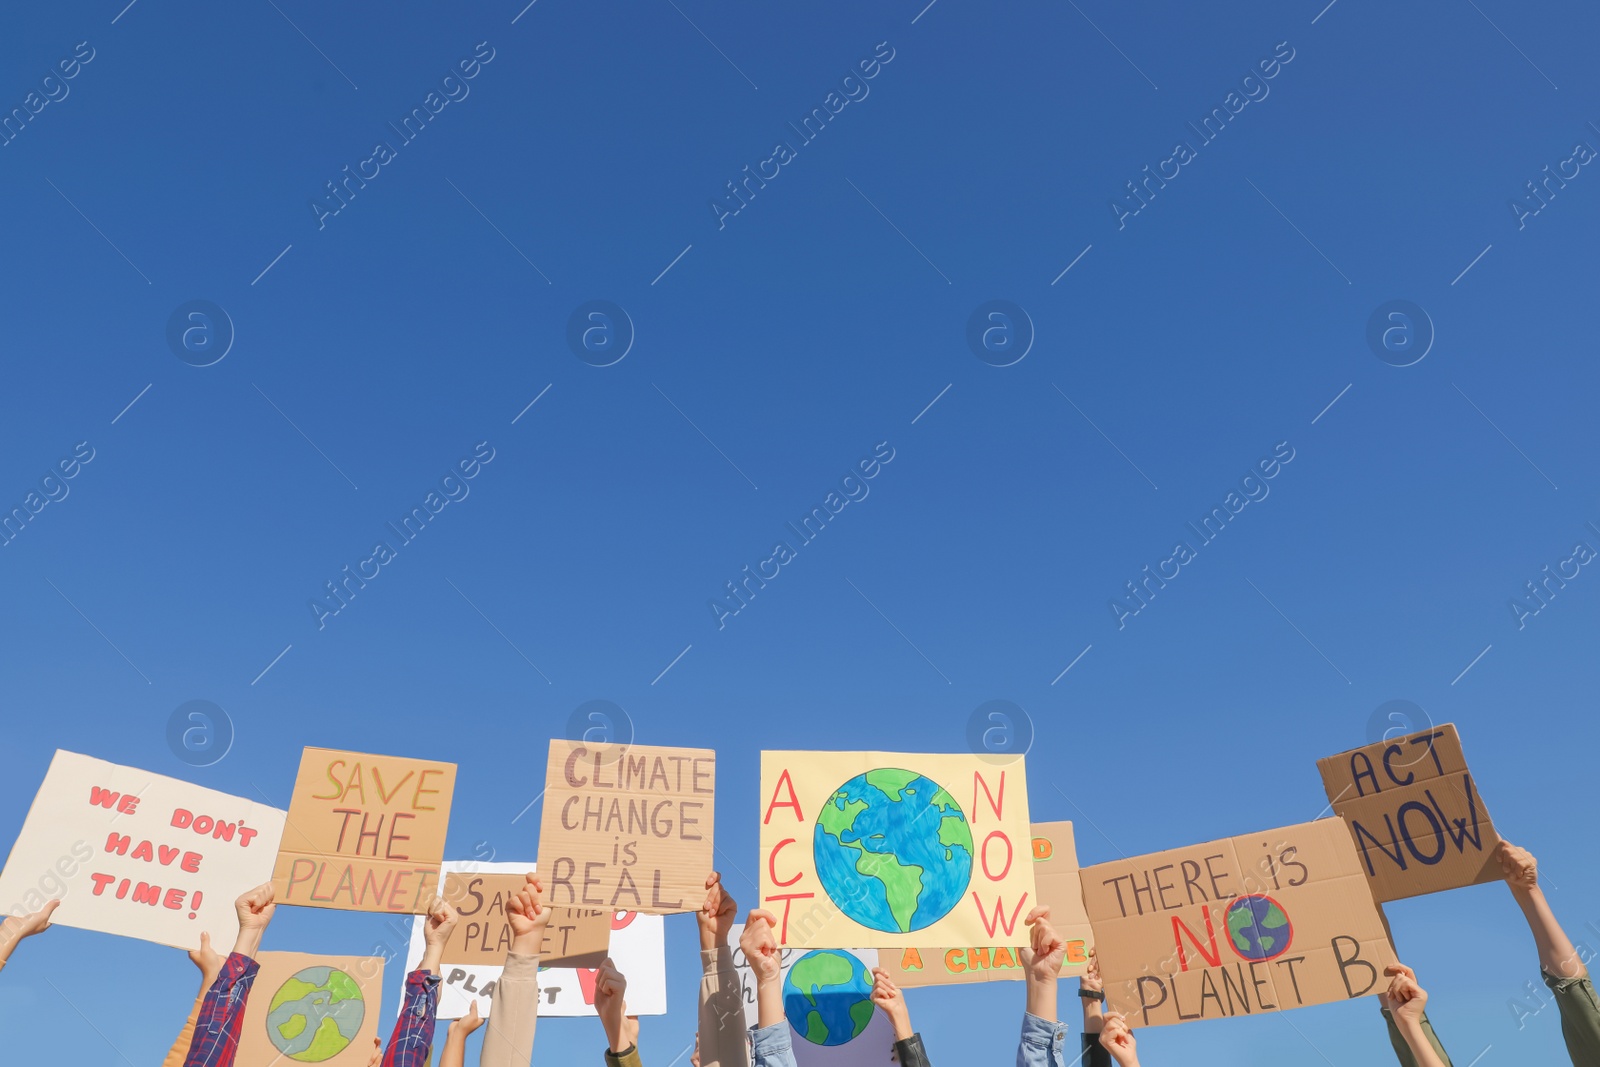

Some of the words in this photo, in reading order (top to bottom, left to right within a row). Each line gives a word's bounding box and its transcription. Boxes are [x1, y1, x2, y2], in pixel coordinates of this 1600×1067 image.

[311, 760, 444, 811] SAVE
[1350, 731, 1444, 797] ACT
[89, 786, 141, 815] WE
[170, 808, 258, 848] DON'T
[332, 808, 416, 861] THE
[561, 795, 704, 840] CHANGE
[1352, 773, 1482, 877] NOW
[104, 832, 203, 873] HAVE
[90, 872, 203, 920] TIME!
[285, 858, 437, 911] PLANET
[550, 857, 683, 908] REAL
[1102, 854, 1237, 918] THERE
[944, 940, 1088, 974] CHAE
[1136, 956, 1306, 1026] PLANET
[1331, 935, 1378, 998] B
